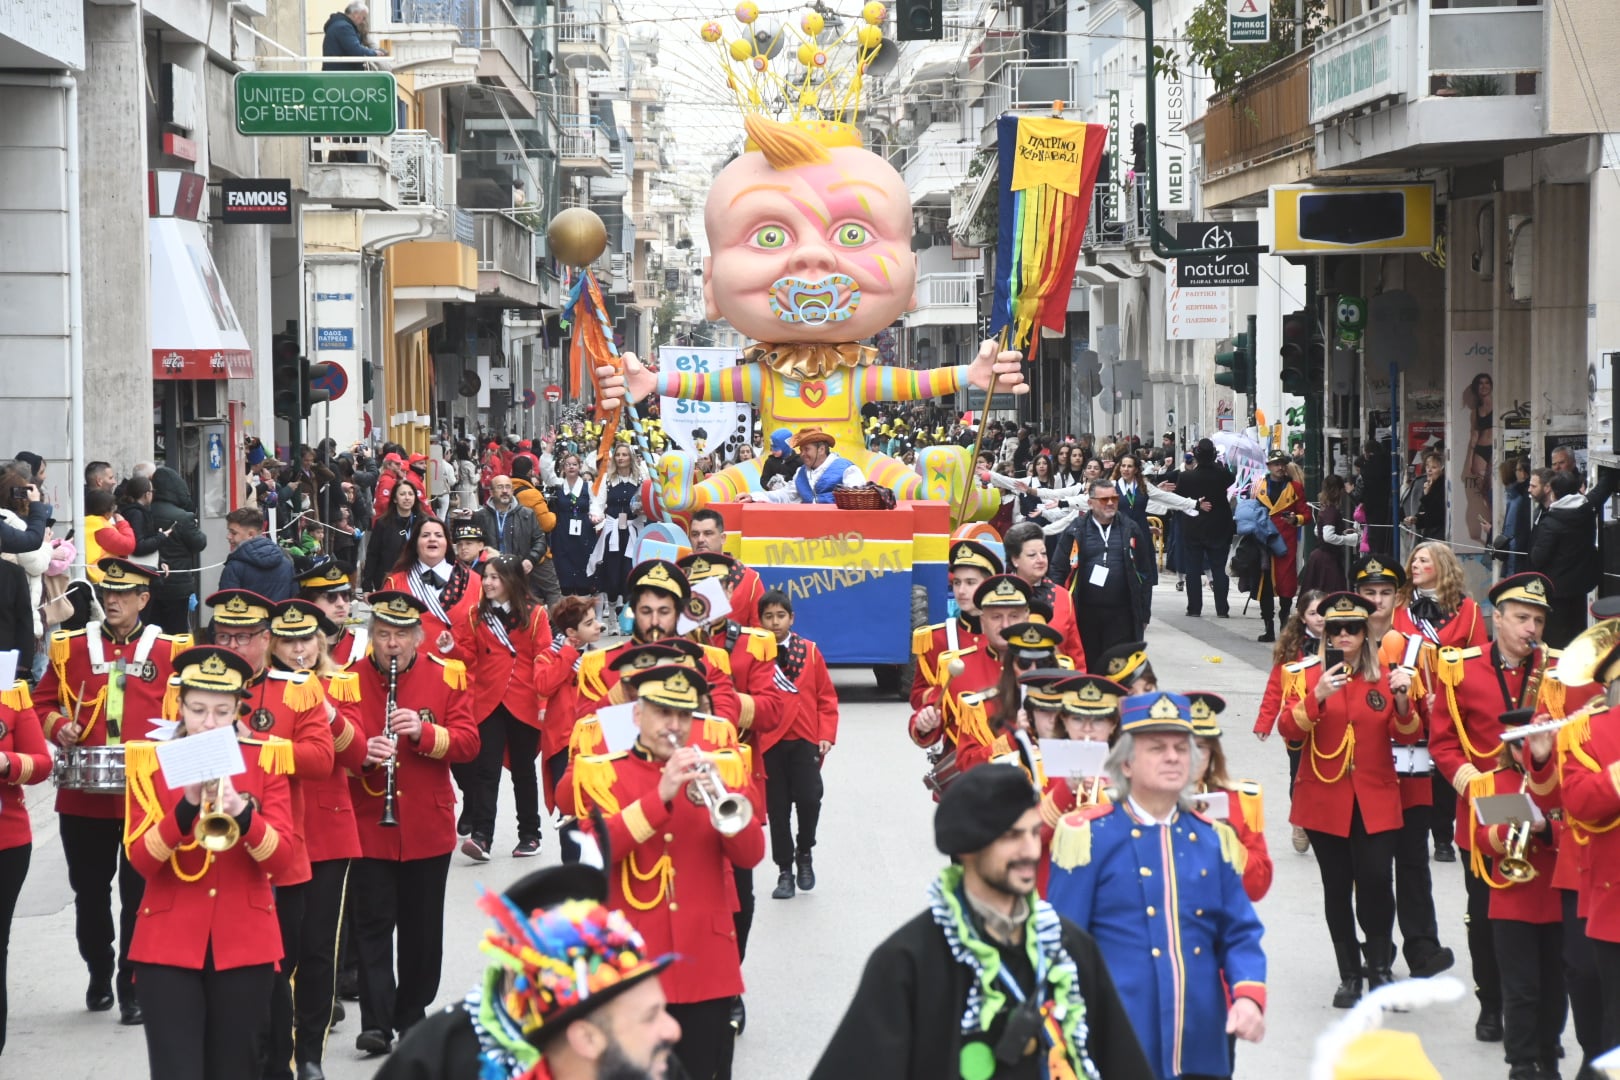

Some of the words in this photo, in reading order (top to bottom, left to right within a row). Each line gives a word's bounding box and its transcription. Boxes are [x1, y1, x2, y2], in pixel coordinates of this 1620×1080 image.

[243, 87, 305, 103] UNITED
[312, 87, 387, 103] COLORS
[244, 106, 269, 121] OF
[274, 105, 373, 122] BENETTON.
[1028, 135, 1076, 152] ΠΑΤΡΙΝΟ
[1109, 93, 1119, 218] ΑΠΟΤΡΙΧΩΣΗ
[1169, 155, 1183, 204] MEDI
[228, 190, 288, 206] FAMOUS
[1184, 262, 1250, 277] natural
[675, 354, 710, 374] ek
[764, 531, 865, 567] ΠΑΤΡΙΝΟ
